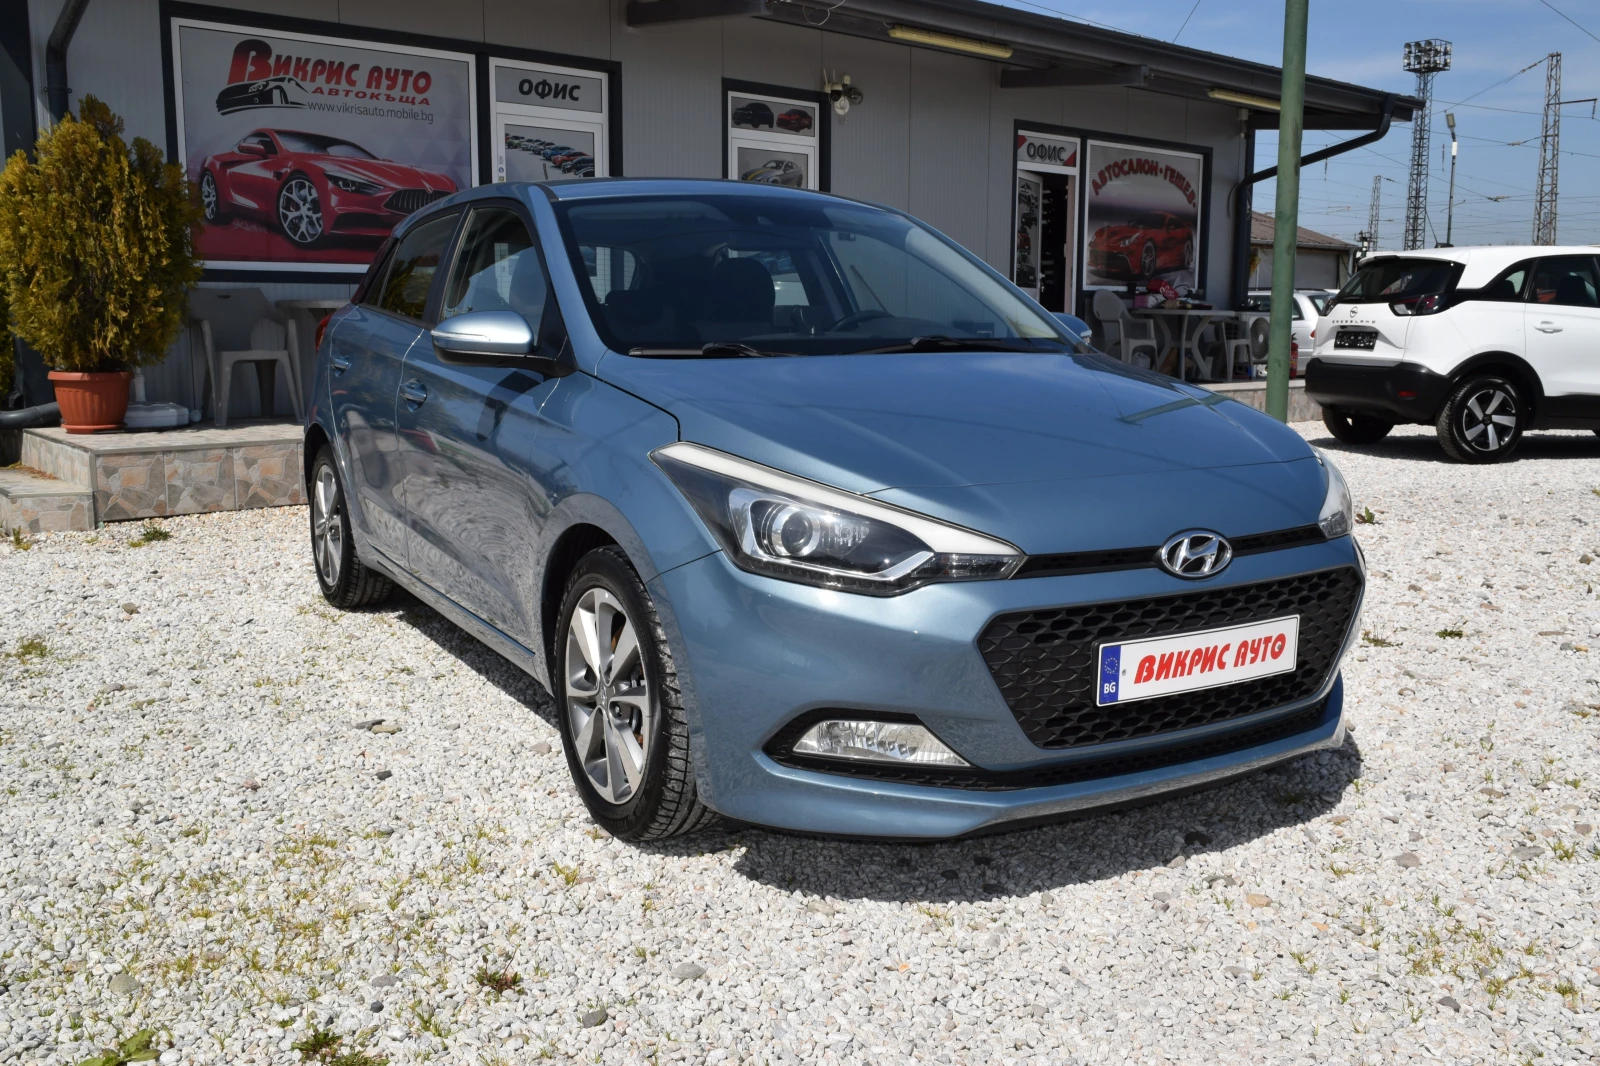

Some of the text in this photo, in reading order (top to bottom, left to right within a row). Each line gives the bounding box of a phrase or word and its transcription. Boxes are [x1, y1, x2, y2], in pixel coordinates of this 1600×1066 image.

[366, 65, 432, 95] АУТО
[518, 78, 581, 101] ОФИС
[311, 86, 430, 106] АВТОКЪЩА
[307, 101, 434, 124] www.vikrisauto.mobile.bg
[1026, 142, 1067, 162] ОФИС
[1091, 157, 1159, 196] АВТОСАЛОН
[1133, 633, 1286, 685] ВИКРИС АУТО
[1104, 682, 1116, 694] BG
